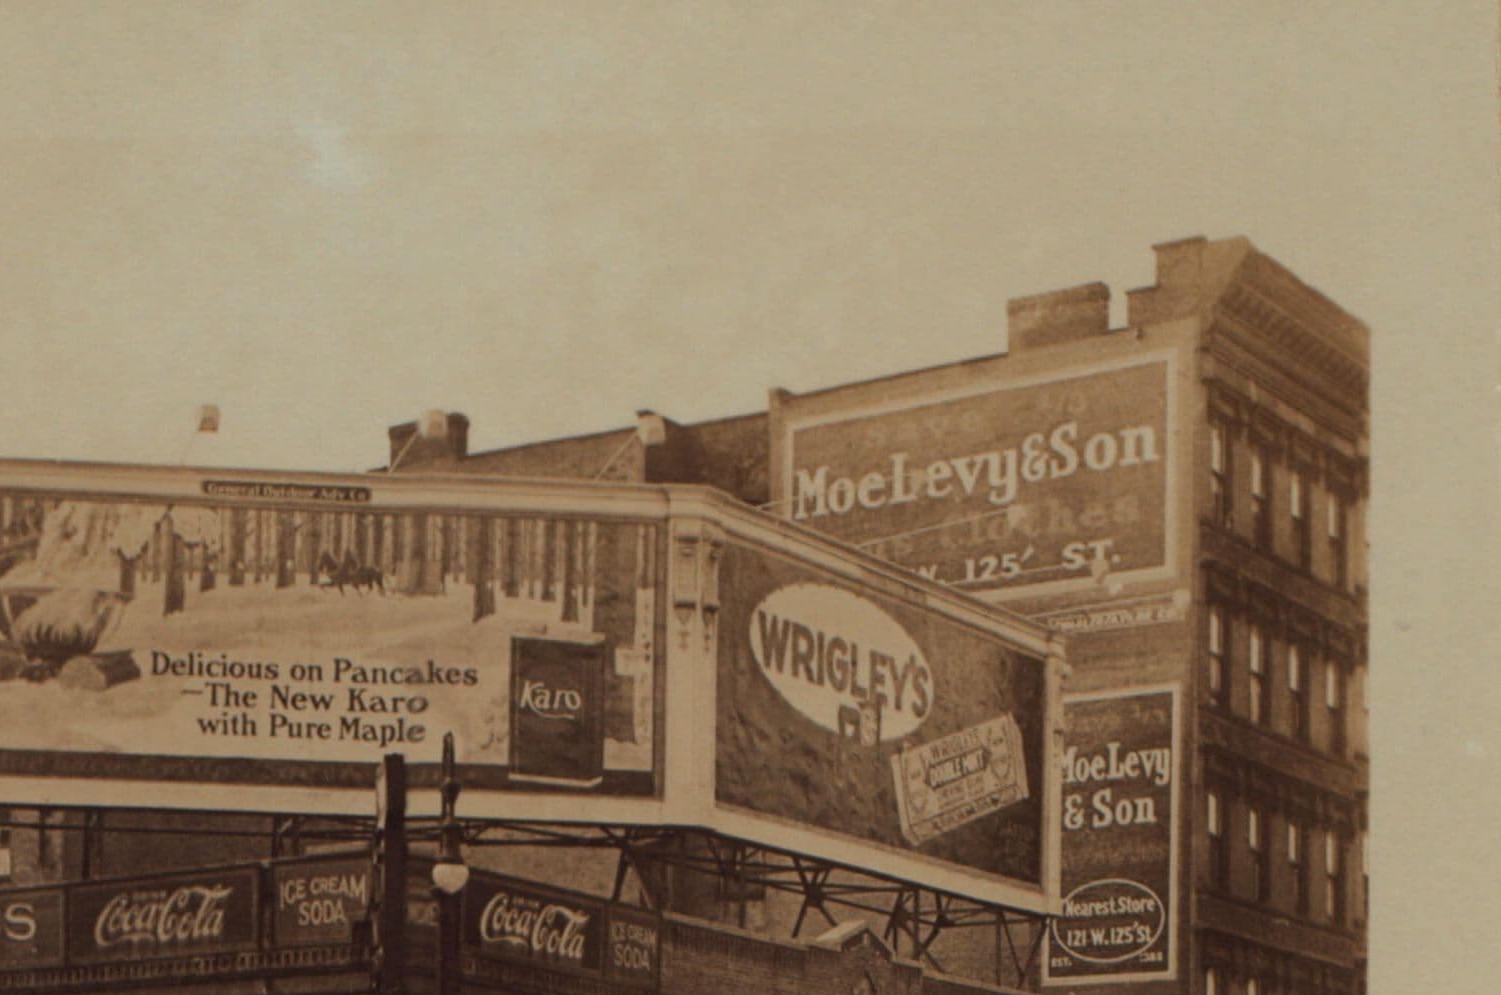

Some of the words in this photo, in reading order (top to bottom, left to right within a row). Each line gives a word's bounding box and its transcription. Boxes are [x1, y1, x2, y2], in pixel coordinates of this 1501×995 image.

[150, 649, 280, 682] Delicious
[288, 660, 325, 684] on
[332, 658, 479, 687] Pancakes
[268, 684, 334, 713] New
[346, 685, 430, 716] Karo
[519, 679, 583, 721] Karo
[196, 714, 258, 740] with
[268, 715, 333, 742] Pure
[337, 717, 427, 748] Maple
[1091, 787, 1158, 829] Son
[279, 874, 308, 913] ICE
[308, 873, 368, 901] CREAM
[1118, 895, 1156, 914] Store
[299, 898, 346, 928] SODA
[615, 944, 651, 971] SODA
